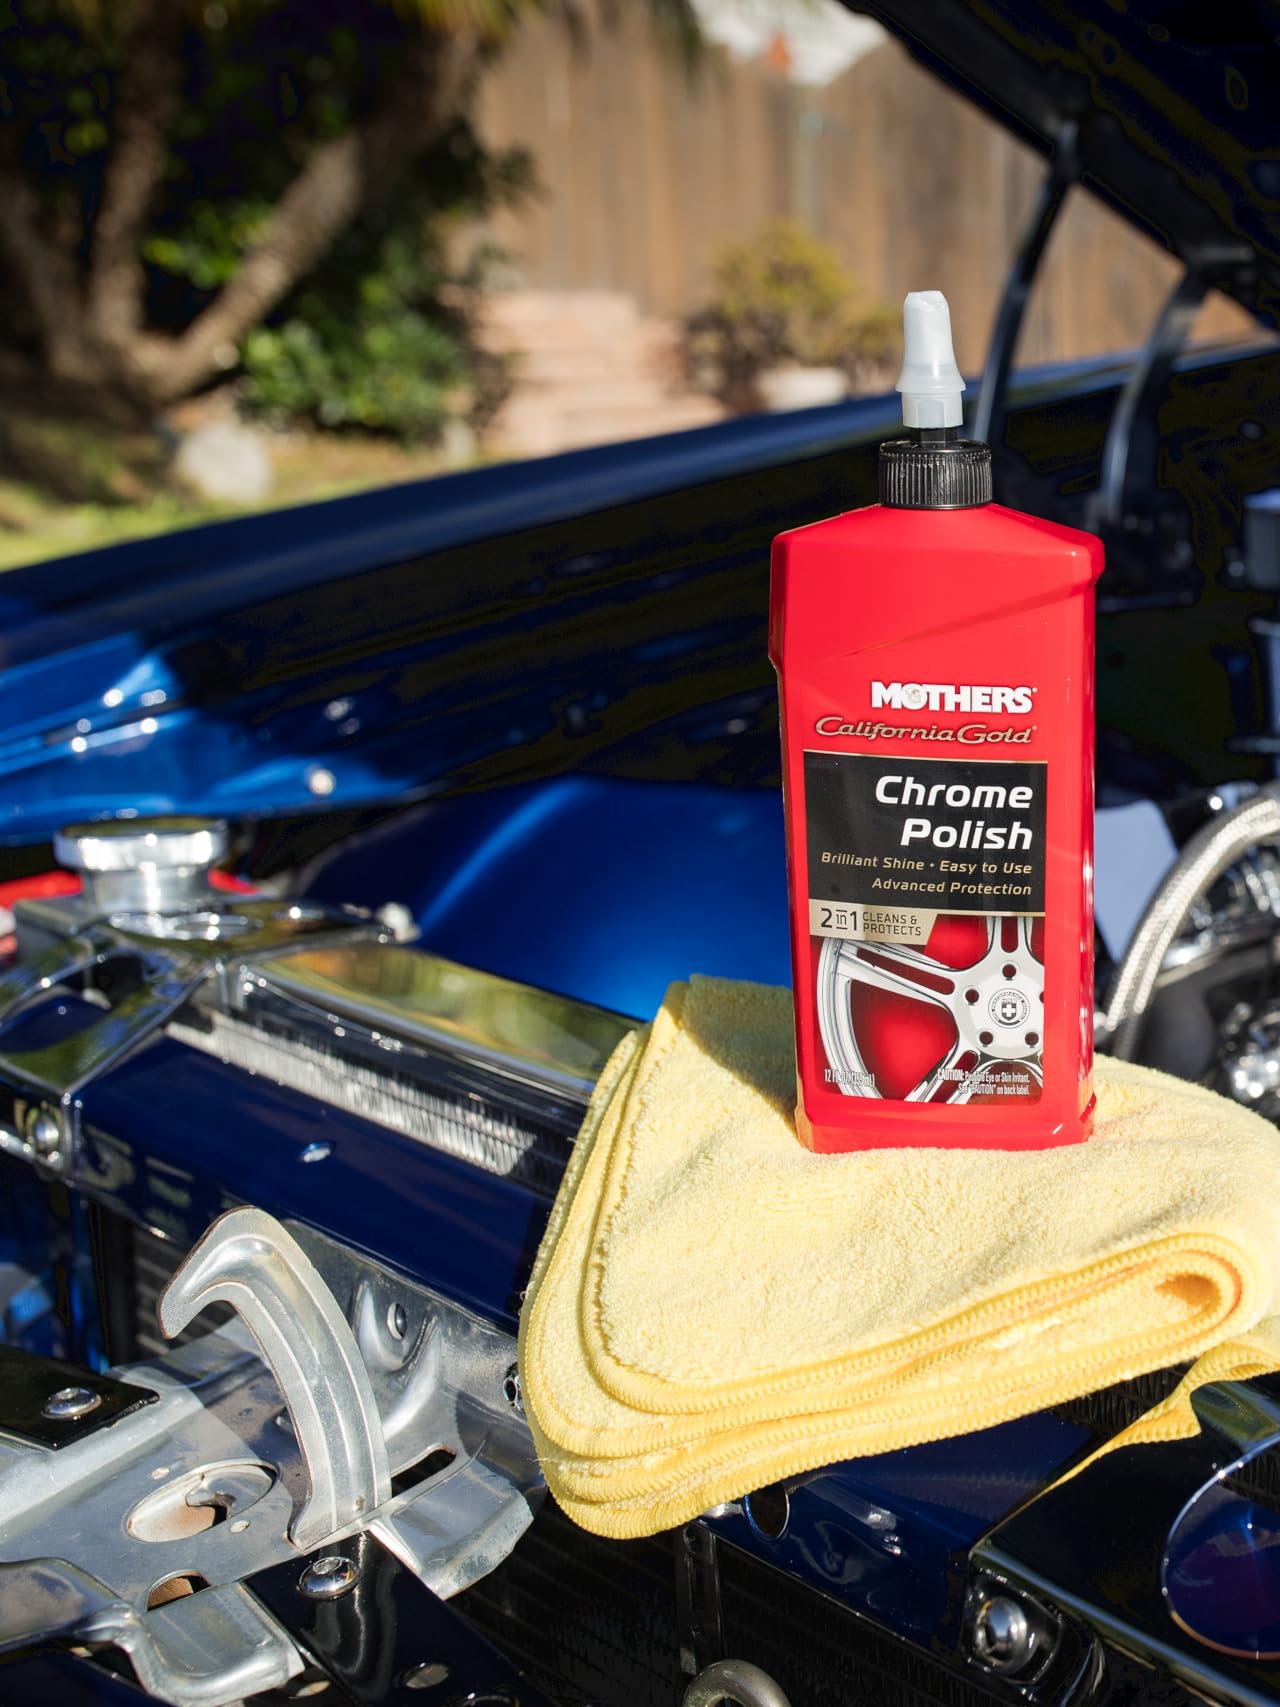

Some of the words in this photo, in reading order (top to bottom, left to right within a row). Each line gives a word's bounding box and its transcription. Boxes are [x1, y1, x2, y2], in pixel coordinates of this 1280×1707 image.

[871, 681, 1033, 714] MOTHERS
[875, 775, 1033, 808] Chrome
[900, 817, 1033, 850] Polish
[821, 852, 878, 868] Brilliant
[882, 857, 925, 871] Shine
[939, 860, 976, 875] Easy
[982, 862, 998, 874] to
[1003, 862, 1033, 874] Use
[872, 877, 945, 893] Advanced
[950, 882, 1033, 896] Protection
[862, 911, 907, 925] CLEANS
[910, 915, 918, 925] &
[863, 923, 922, 936] PROTECTS
